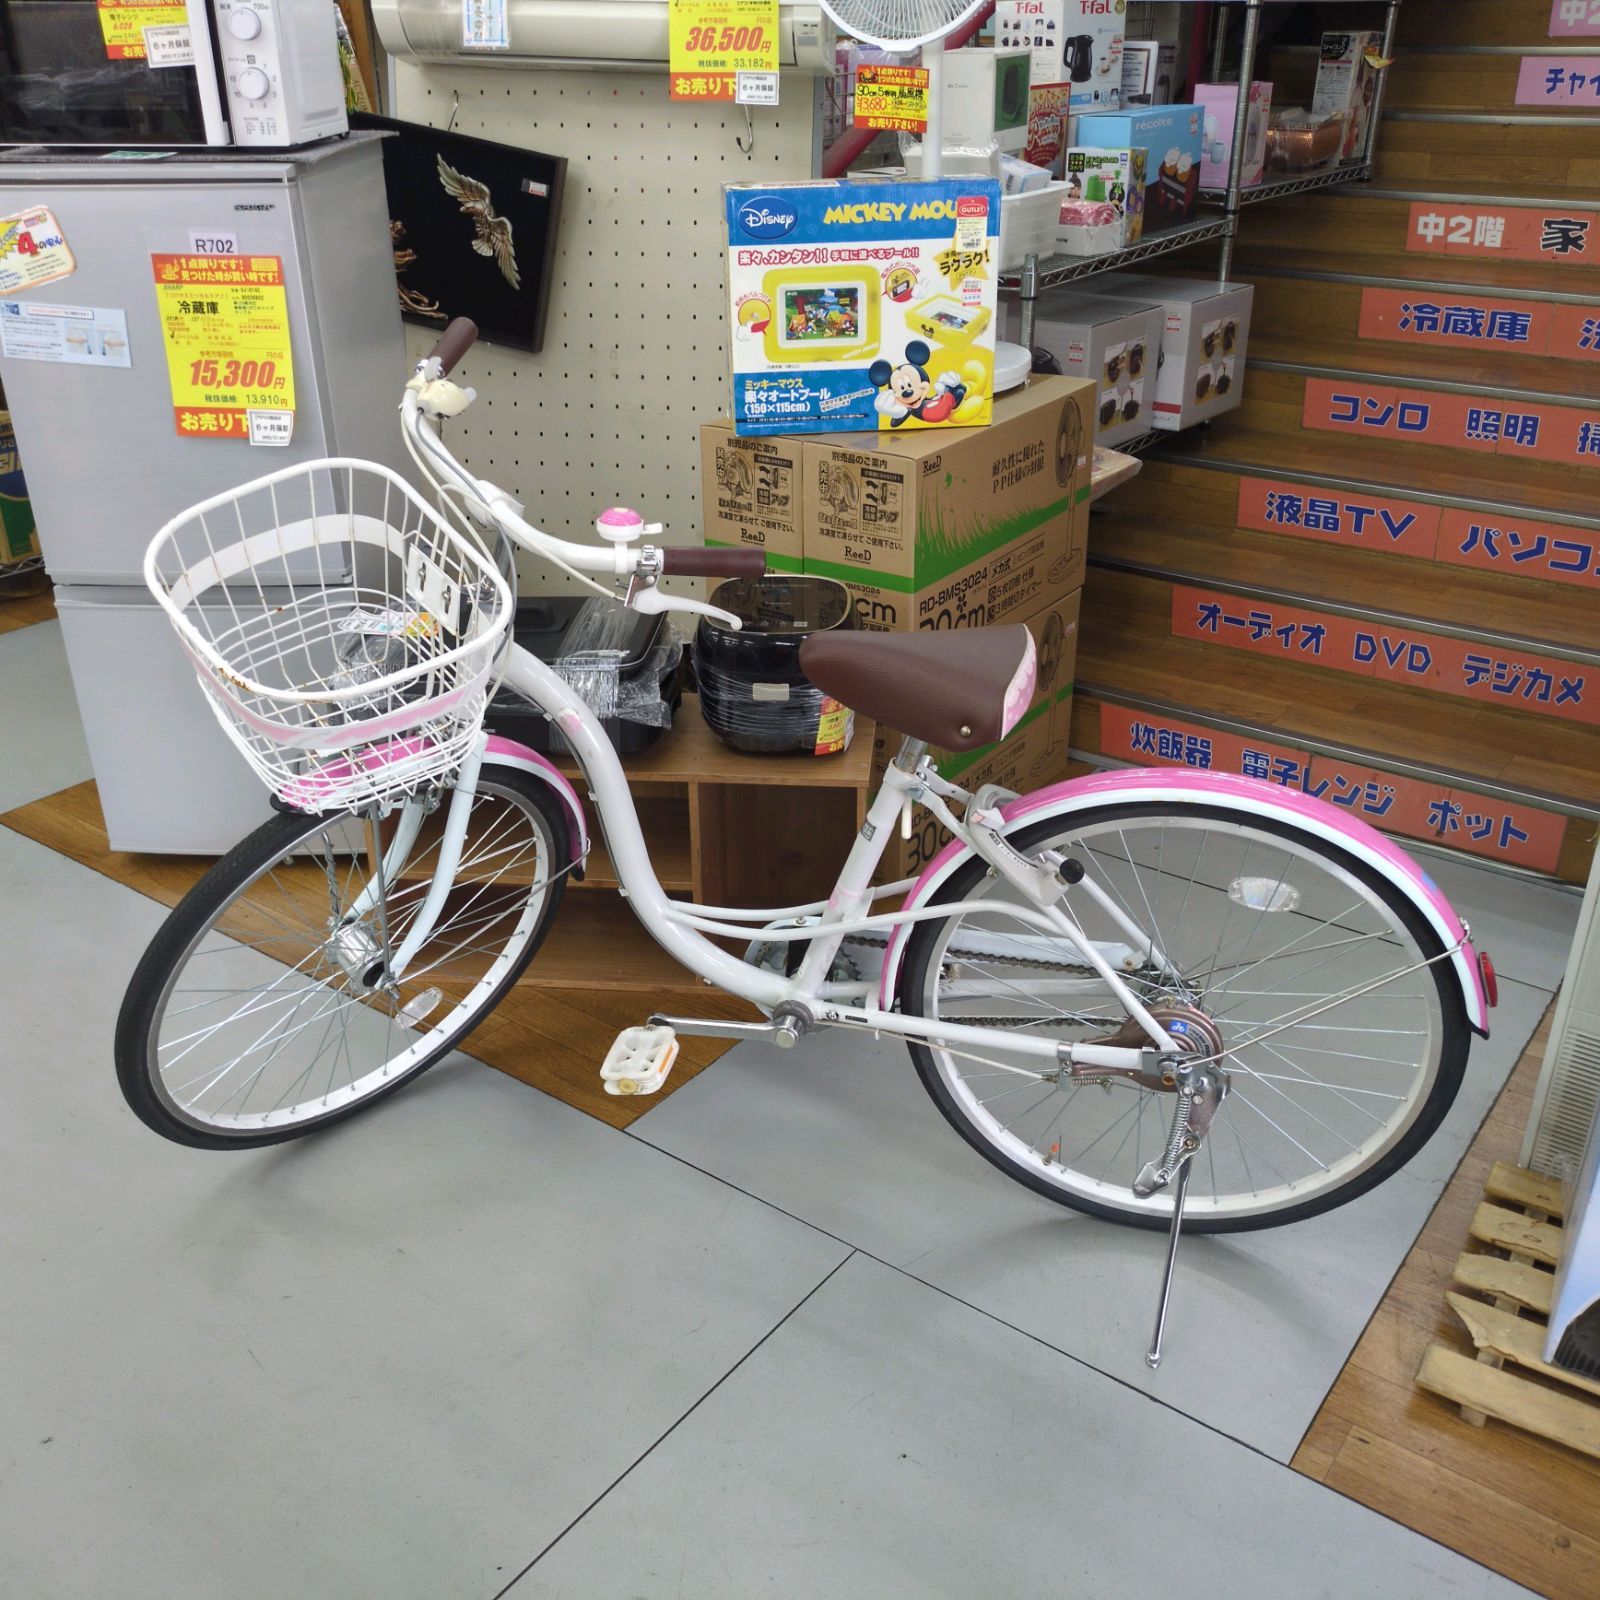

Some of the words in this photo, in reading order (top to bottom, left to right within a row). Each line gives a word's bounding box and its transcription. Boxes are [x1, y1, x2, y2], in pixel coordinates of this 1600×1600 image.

[685, 26, 772, 53] 36,500円
[734, 59, 773, 69] 33,182円
[1135, 117, 1173, 131] récolte
[823, 202, 907, 224] MICKEY
[909, 200, 958, 220] MOU
[1416, 212, 1505, 248] 中2階
[1540, 217, 1590, 254] 家
[195, 239, 234, 253] R702
[178, 300, 220, 315] 冷蔵庫
[1398, 303, 1532, 342] 冷蔵庫
[190, 359, 286, 389] 15,300円
[745, 379, 804, 390] ミッキーマウス
[246, 394, 288, 406] 13,910円
[745, 388, 831, 403] 楽々オートプール
[1330, 393, 1430, 432] コンロ
[1465, 408, 1540, 447] 照明
[832, 451, 888, 469] 別売品のご案内
[923, 454, 942, 473] ReeD
[992, 439, 1045, 477] 耐久性に優れた
[740, 528, 765, 543] ReeD
[1265, 490, 1417, 541] 液晶TV
[1459, 524, 1600, 577] パソコ
[844, 546, 872, 560] ReeD
[919, 566, 988, 616] RD-BMS3024
[1197, 603, 1326, 656] オーディオ
[1353, 636, 1432, 674] DVD
[1463, 653, 1585, 705] デジカメ
[1130, 721, 1212, 769] 炊飯器
[1241, 748, 1395, 817] 電子レンジ
[1426, 799, 1528, 849] ポット
